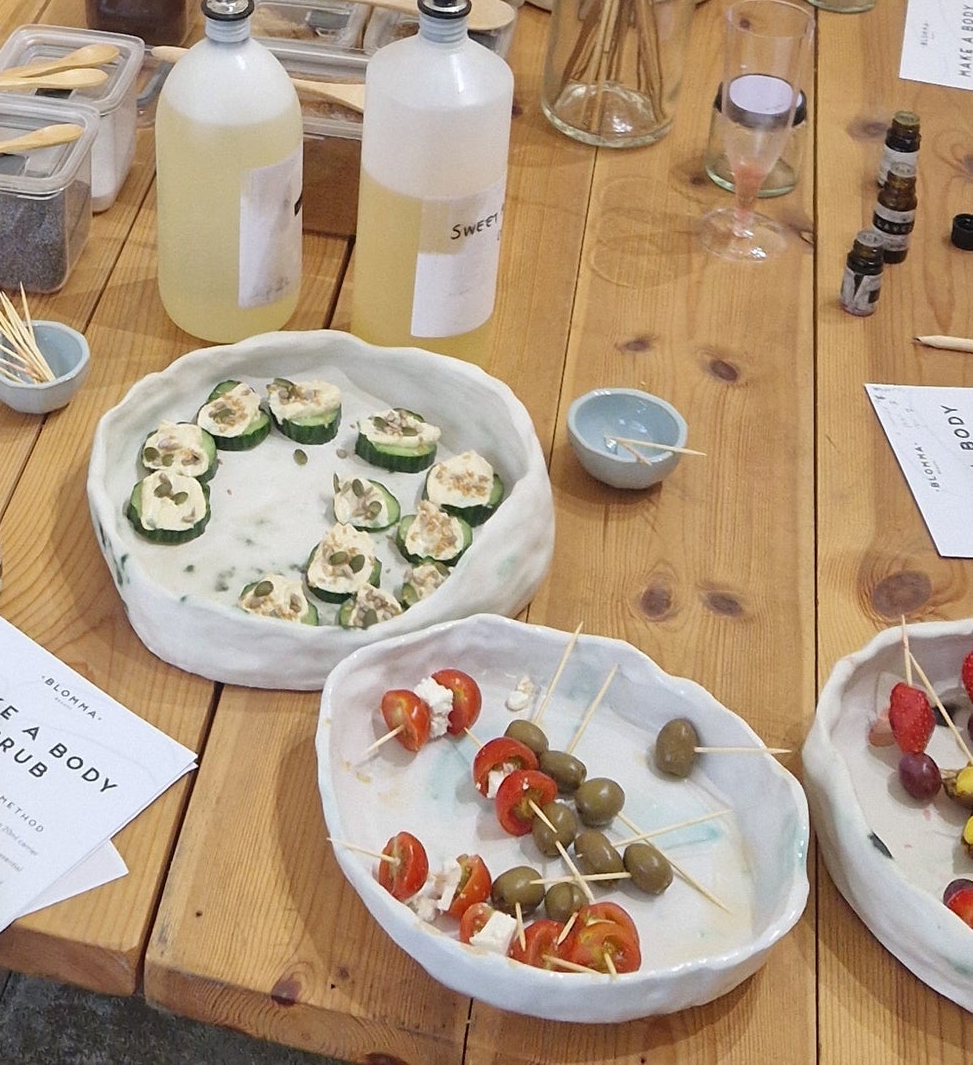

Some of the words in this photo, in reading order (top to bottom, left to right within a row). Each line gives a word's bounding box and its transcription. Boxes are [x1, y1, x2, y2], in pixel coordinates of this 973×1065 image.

[450, 212, 498, 240] SWEET
[941, 405, 973, 451] BODY
[915, 445, 940, 488] BLOMMA
[45, 678, 96, 719] BLOMMA
[22, 726, 40, 741] A
[49, 743, 117, 792] BODY
[0, 795, 44, 833] METHOD
